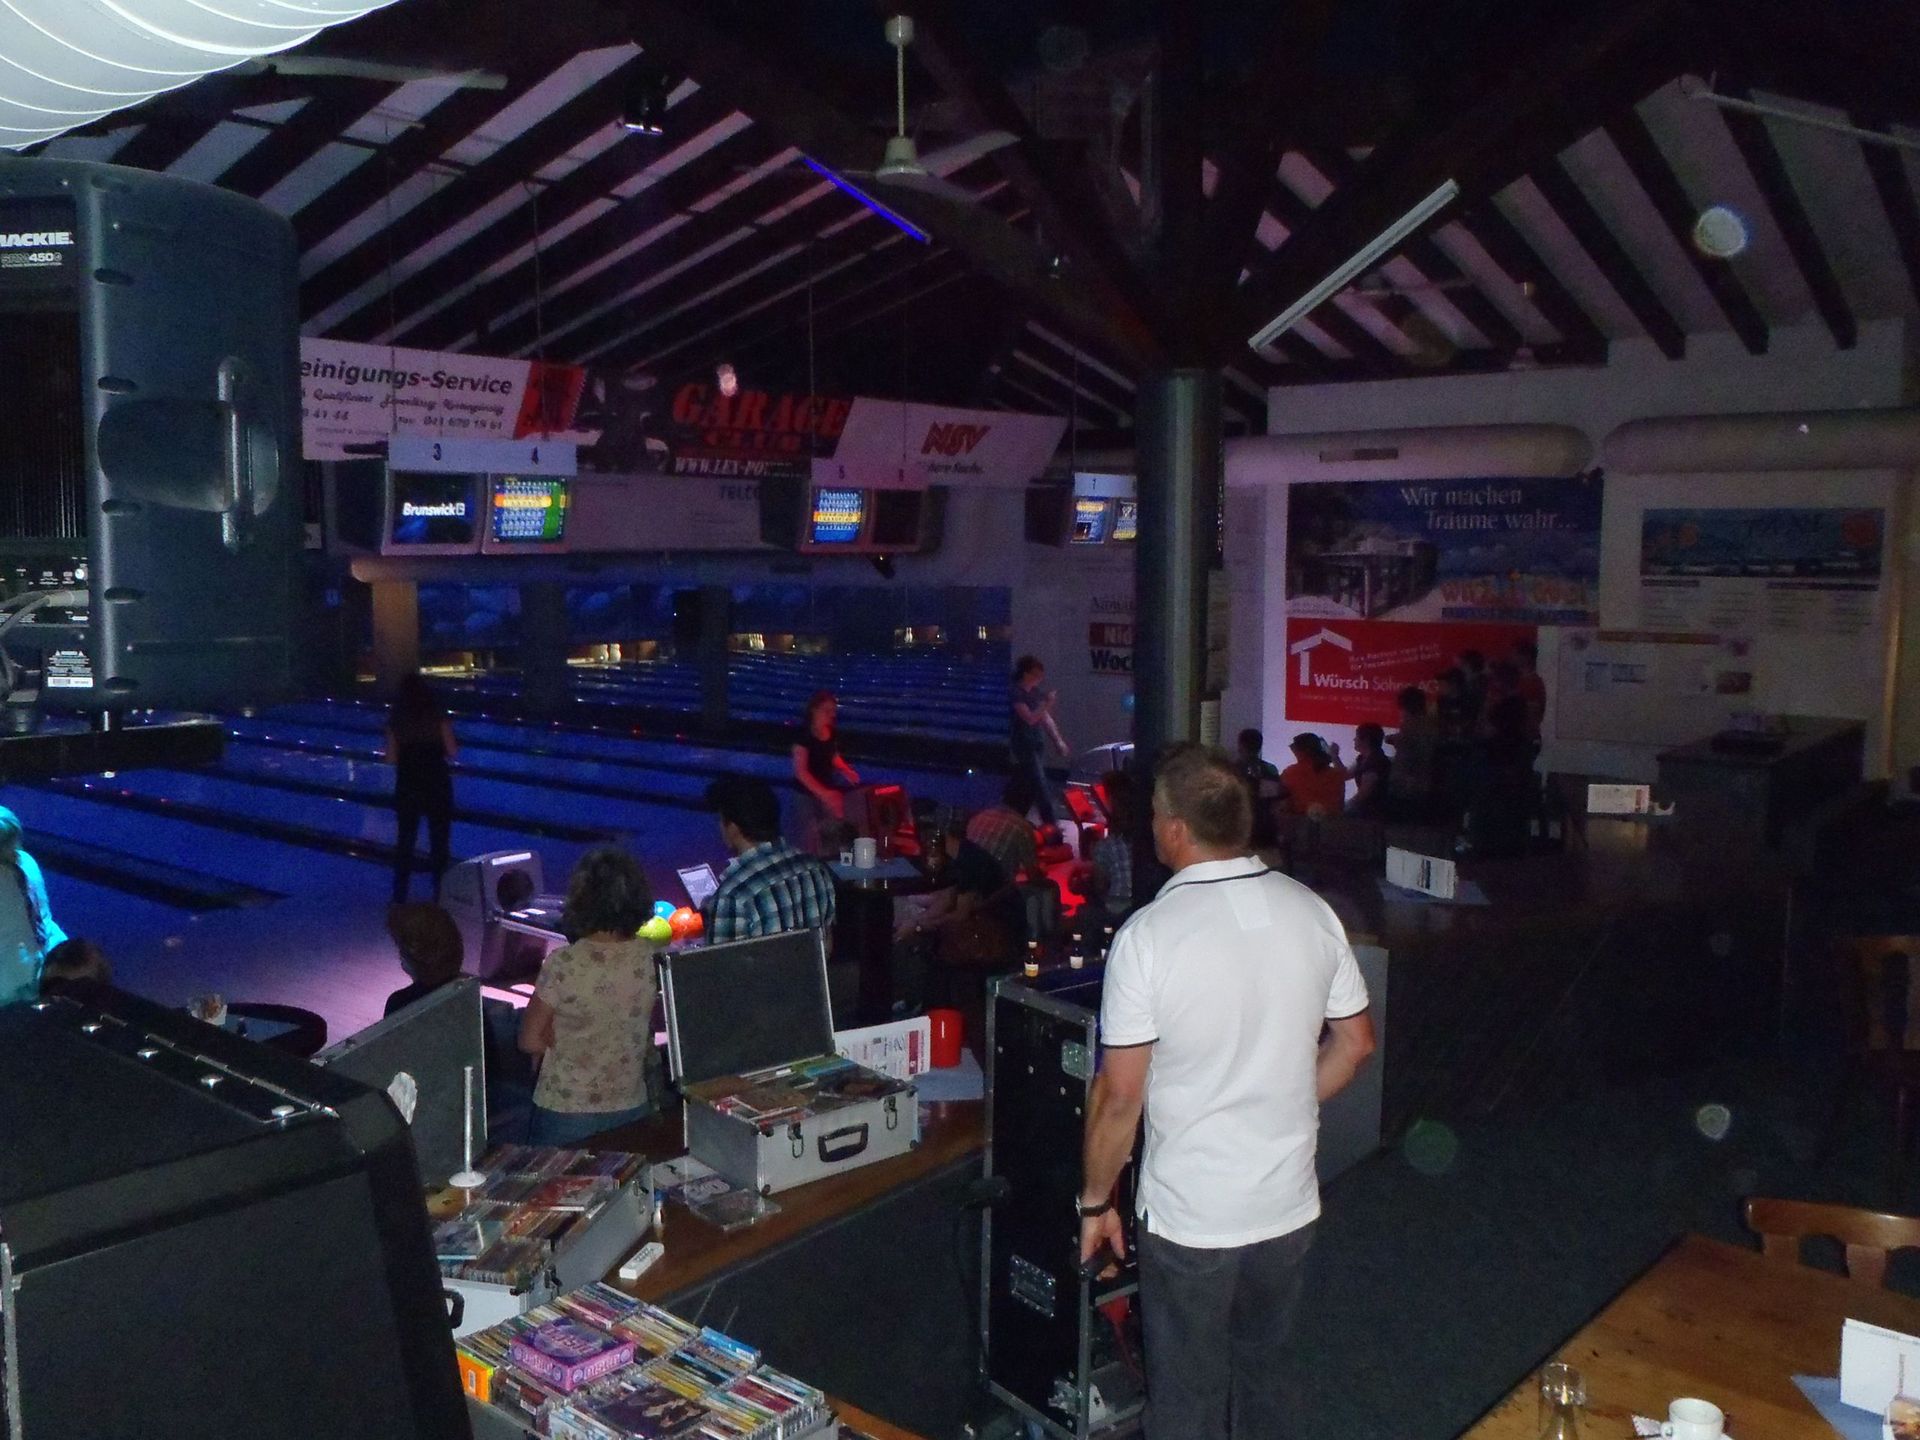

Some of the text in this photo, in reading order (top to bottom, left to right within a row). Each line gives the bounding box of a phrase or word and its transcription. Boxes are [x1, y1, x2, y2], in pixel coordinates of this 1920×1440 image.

[300, 358, 513, 395] einigungs-Service
[673, 383, 853, 434] GARAGE
[921, 422, 990, 456] NSV
[432, 442, 442, 462] 3
[530, 446, 540, 465] 4
[1400, 485, 1522, 506] Wir machen
[402, 502, 456, 516] Brunswick
[1090, 649, 1137, 671] Woc
[1313, 673, 1369, 689] Würsch
[1417, 679, 1440, 693] AG
